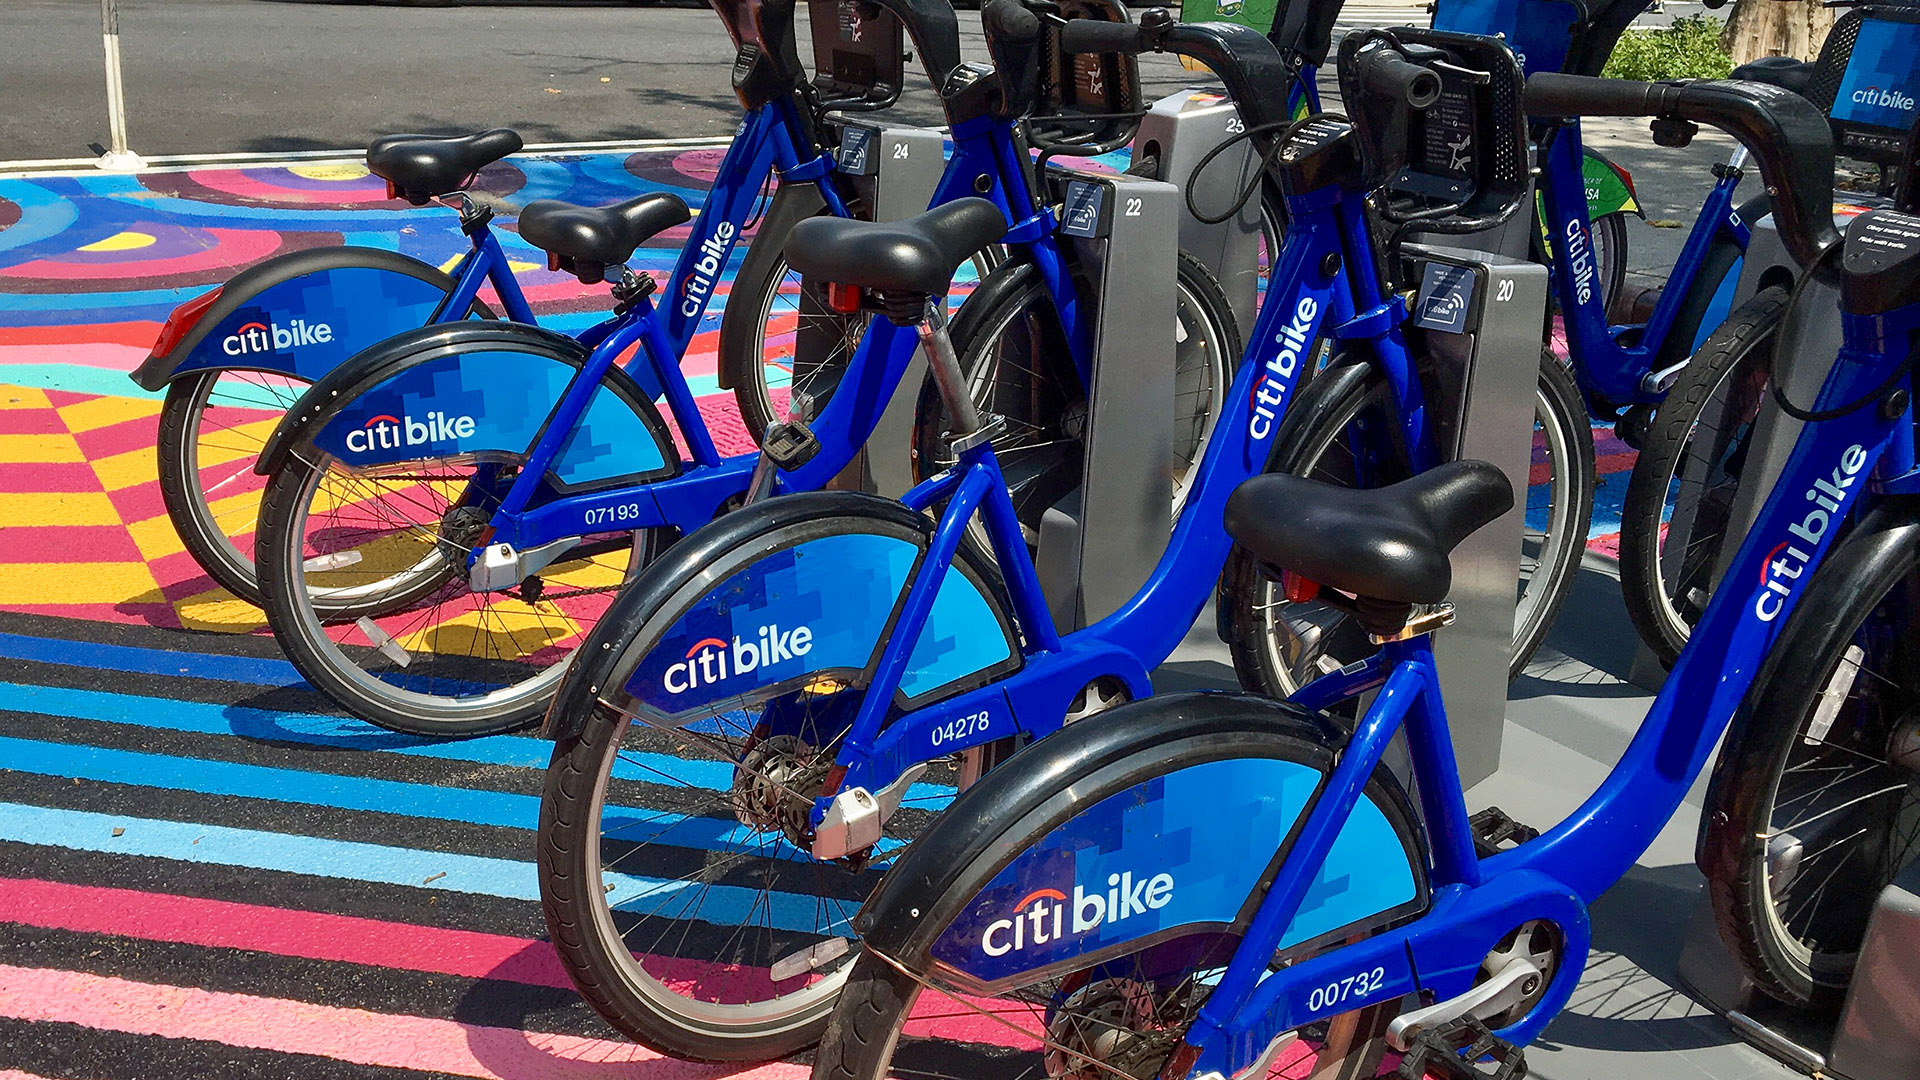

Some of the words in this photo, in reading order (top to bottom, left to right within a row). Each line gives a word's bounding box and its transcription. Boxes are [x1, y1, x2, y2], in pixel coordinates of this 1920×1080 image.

[1852, 86, 1880, 105] citi
[1878, 90, 1914, 111] bike
[1225, 118, 1245, 133] 25
[893, 143, 910, 159] 24
[1125, 198, 1142, 216] 22
[694, 221, 735, 277] bike
[1567, 219, 1589, 258] citi
[682, 272, 710, 317] citi
[1496, 279, 1514, 302] 20
[1572, 251, 1593, 305] bike
[223, 322, 269, 356] citi
[271, 320, 333, 349] bike
[1265, 297, 1317, 379] bike
[1250, 374, 1286, 440] citi
[346, 415, 401, 452] citi
[404, 411, 475, 445] bike
[584, 503, 640, 525] 07193
[1755, 541, 1810, 622] citi
[1788, 444, 1867, 545] bike
[663, 637, 728, 694] citi
[731, 623, 813, 676] bike
[931, 710, 990, 747] 04278
[981, 888, 1068, 957] citi
[1072, 870, 1175, 934] bike
[1308, 966, 1385, 1012] 00732
